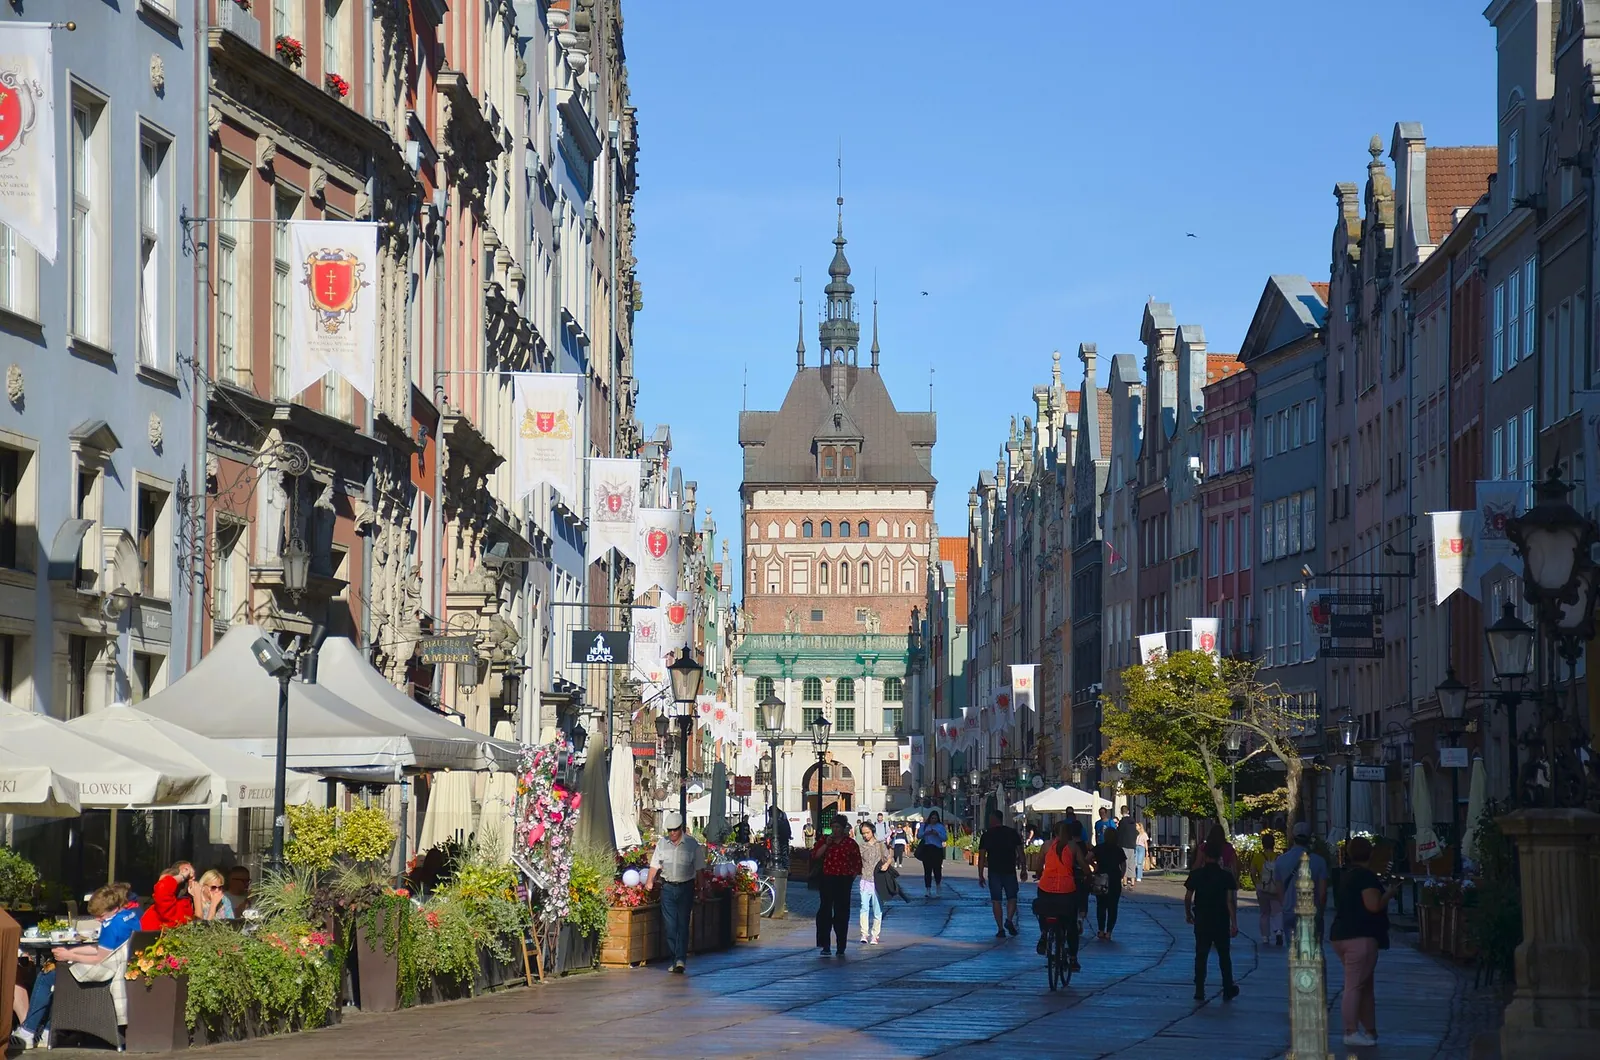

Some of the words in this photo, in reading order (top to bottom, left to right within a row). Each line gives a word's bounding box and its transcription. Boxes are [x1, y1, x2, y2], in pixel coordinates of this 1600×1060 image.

[423, 654, 469, 662] AMBER
[586, 654, 614, 662] BAR
[78, 783, 132, 795] LOWSKI
